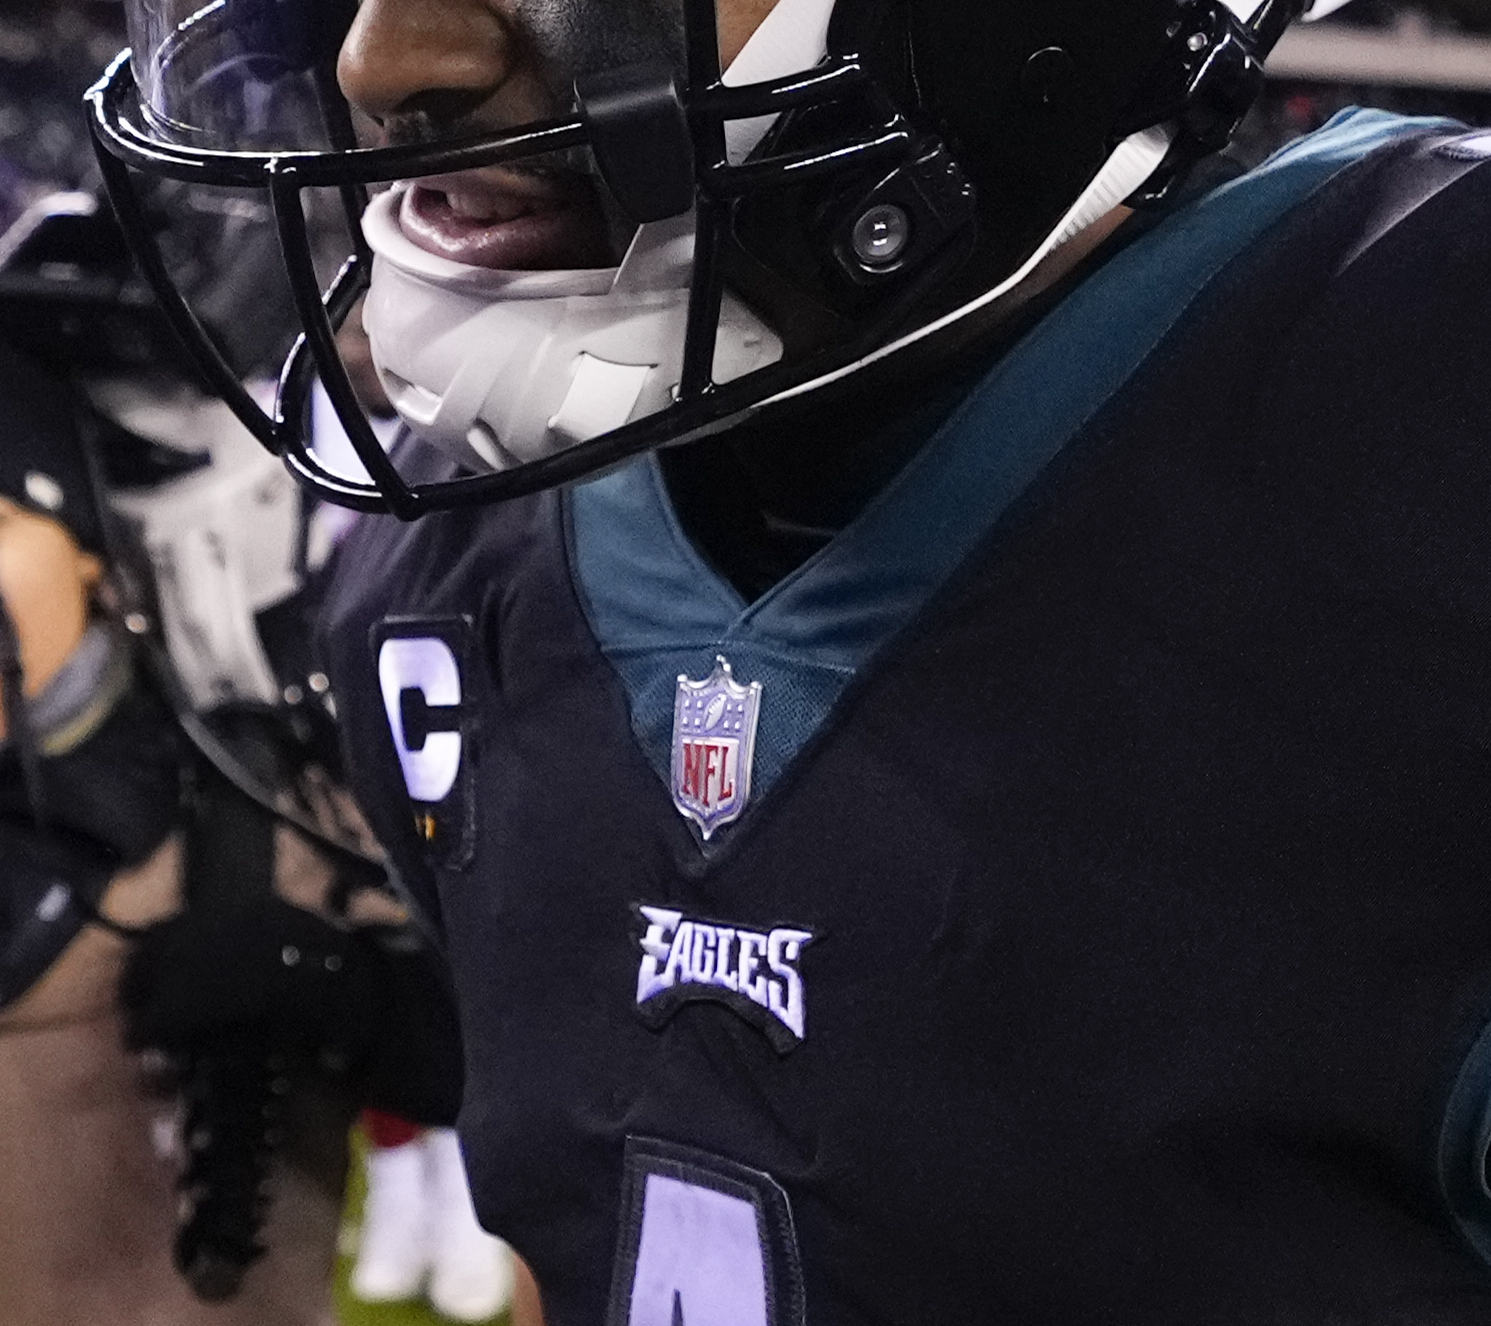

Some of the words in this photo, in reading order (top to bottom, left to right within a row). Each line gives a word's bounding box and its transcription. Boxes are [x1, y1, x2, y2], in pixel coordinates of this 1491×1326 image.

[378, 636, 462, 803] C
[682, 742, 734, 808] NFL
[636, 905, 814, 1040] EAGLES
